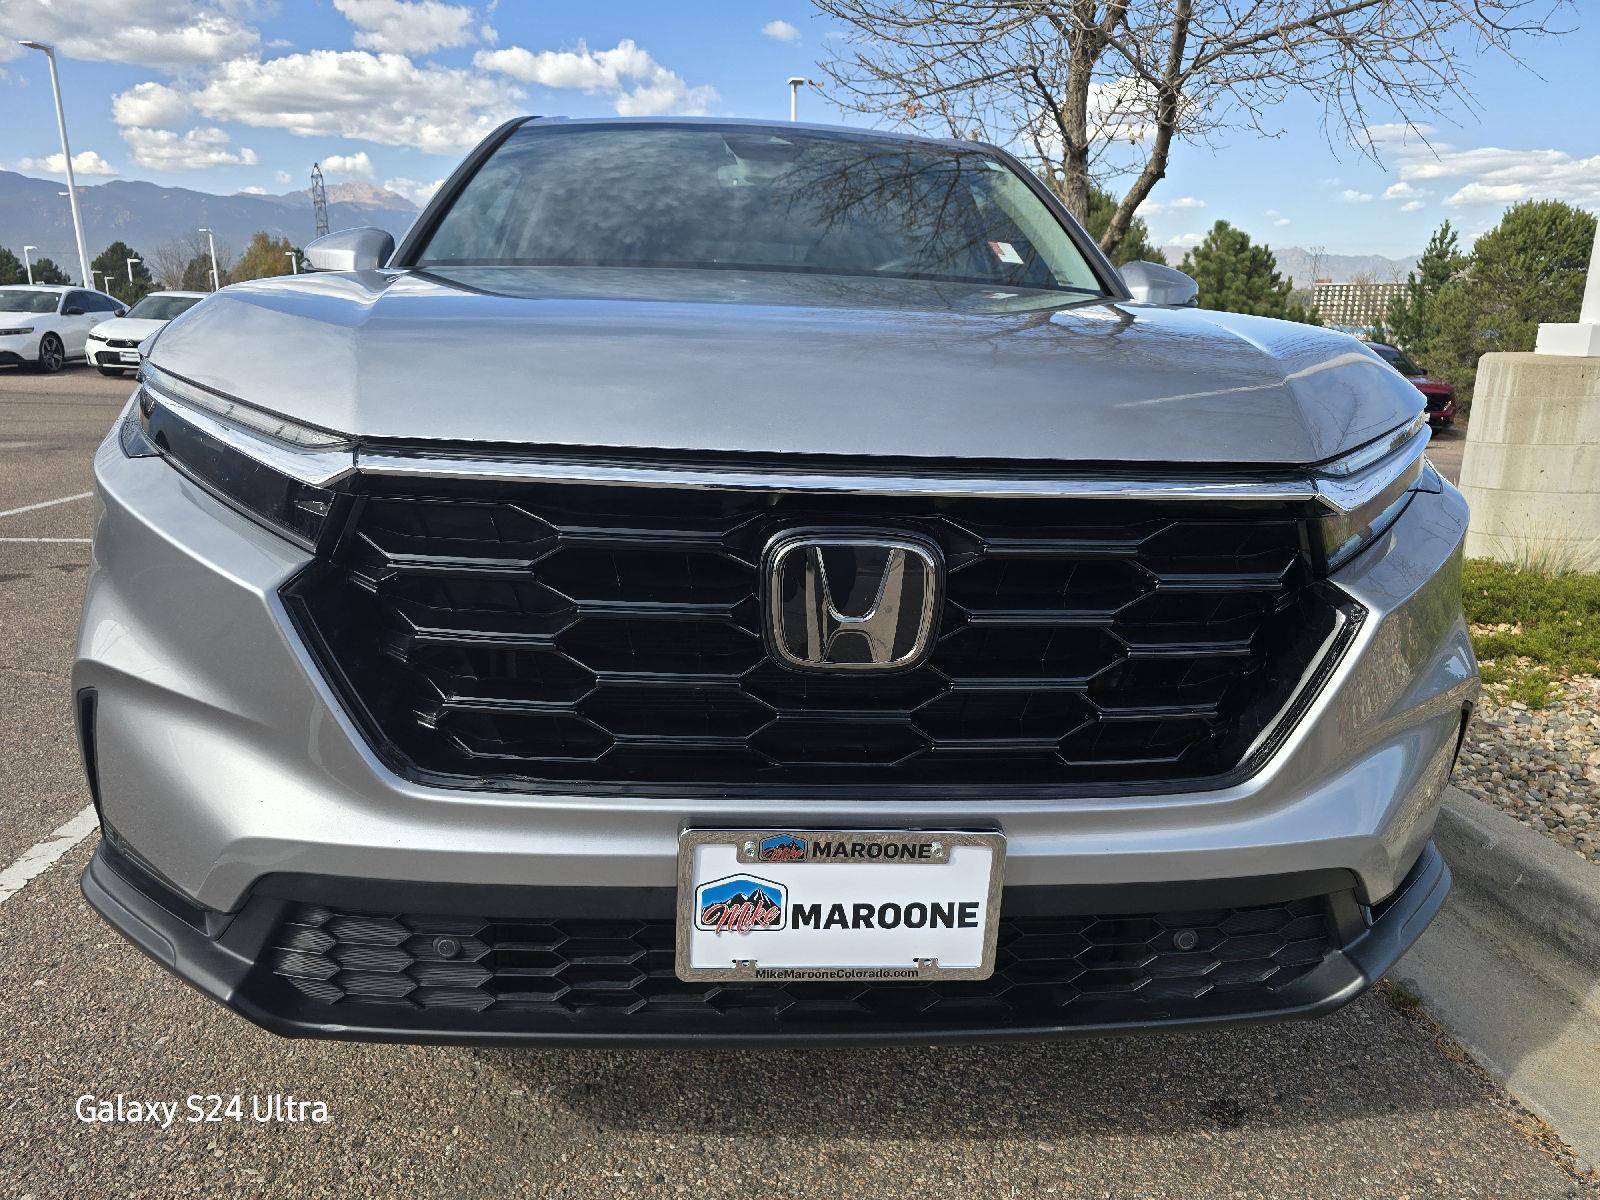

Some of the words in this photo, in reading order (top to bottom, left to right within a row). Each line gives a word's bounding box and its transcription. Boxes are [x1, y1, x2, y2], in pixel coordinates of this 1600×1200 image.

[812, 841, 933, 859] MAROONE
[701, 899, 781, 937] Mike
[791, 901, 980, 930] MAROONE
[755, 969, 919, 980] MikeMarooneColorado.com
